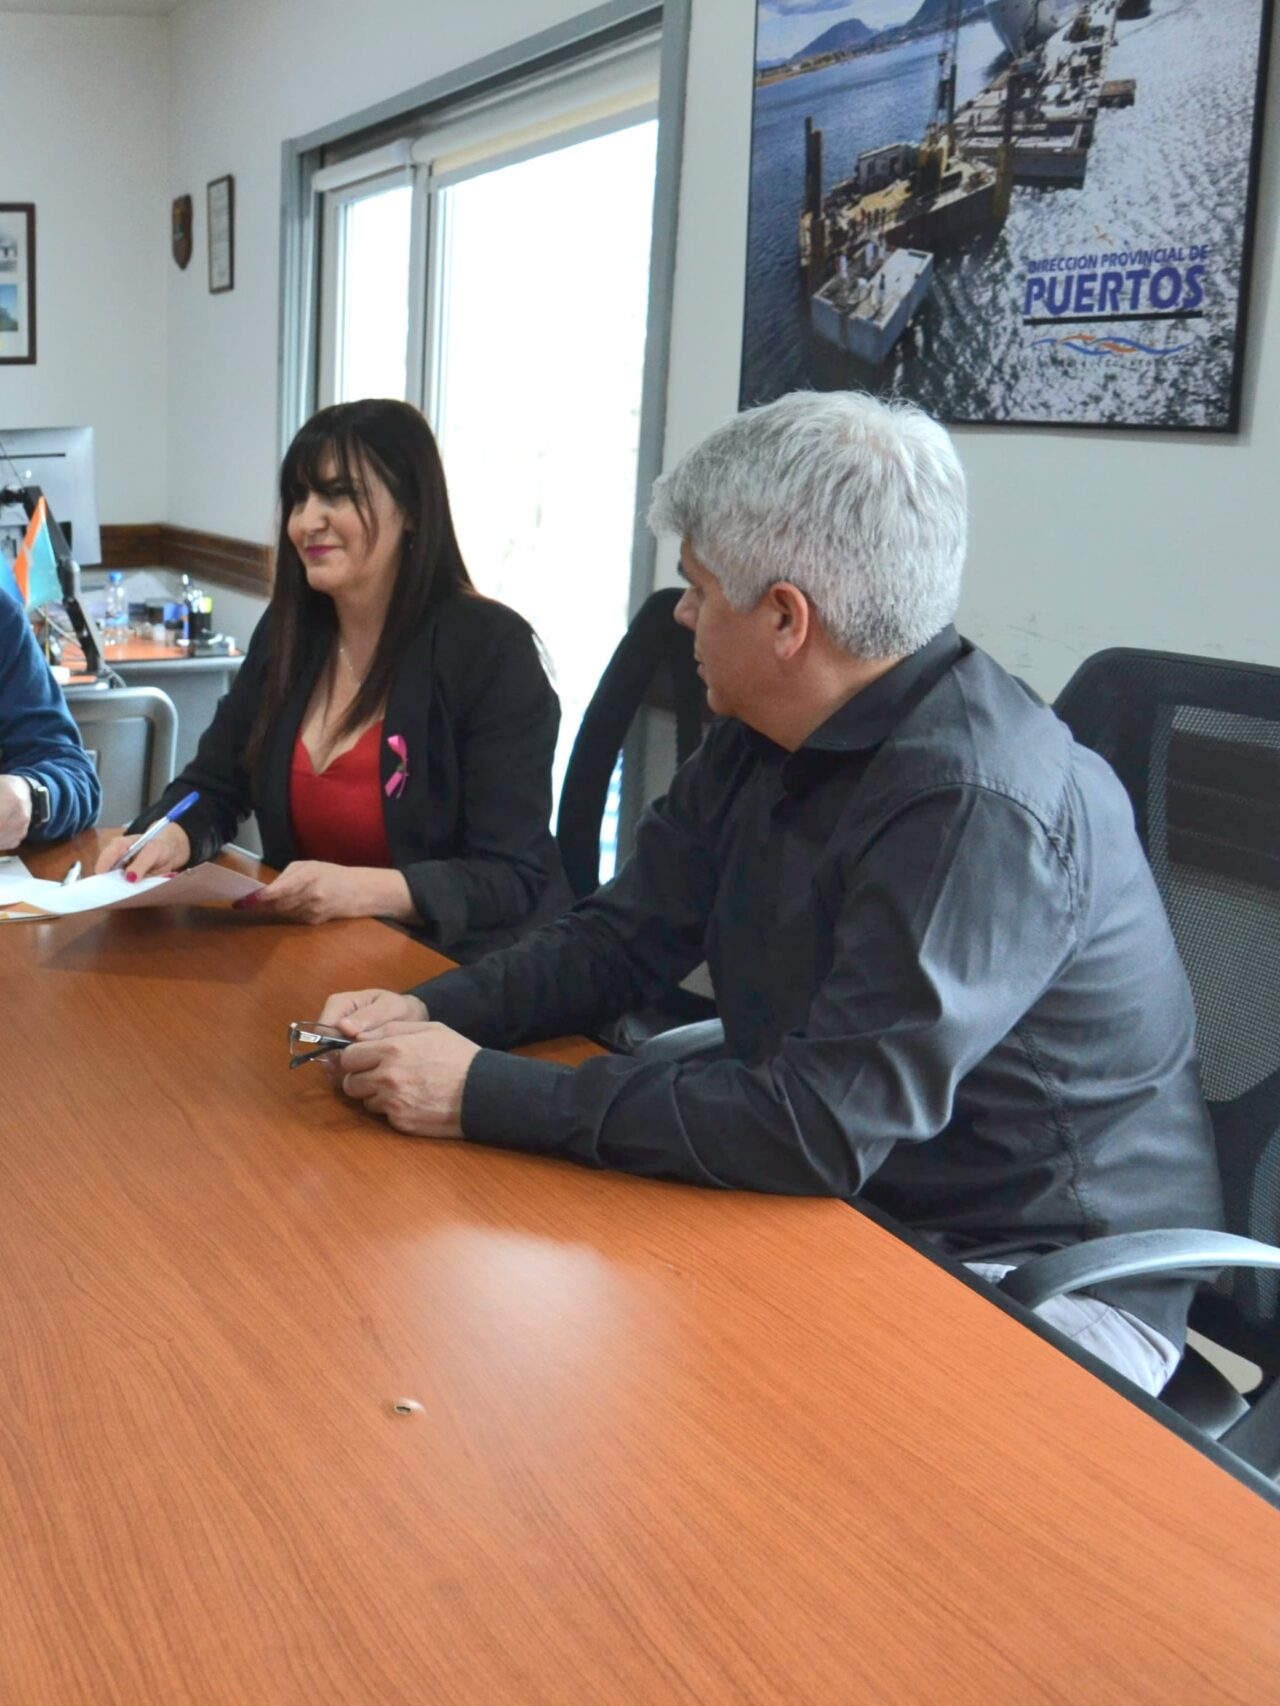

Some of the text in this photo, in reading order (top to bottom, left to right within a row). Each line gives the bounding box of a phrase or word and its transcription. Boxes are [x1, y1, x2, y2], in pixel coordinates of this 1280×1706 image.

[1027, 244, 1209, 273] DIRECCION PROVINCIAL DE
[1023, 265, 1206, 316] PUERTOS
